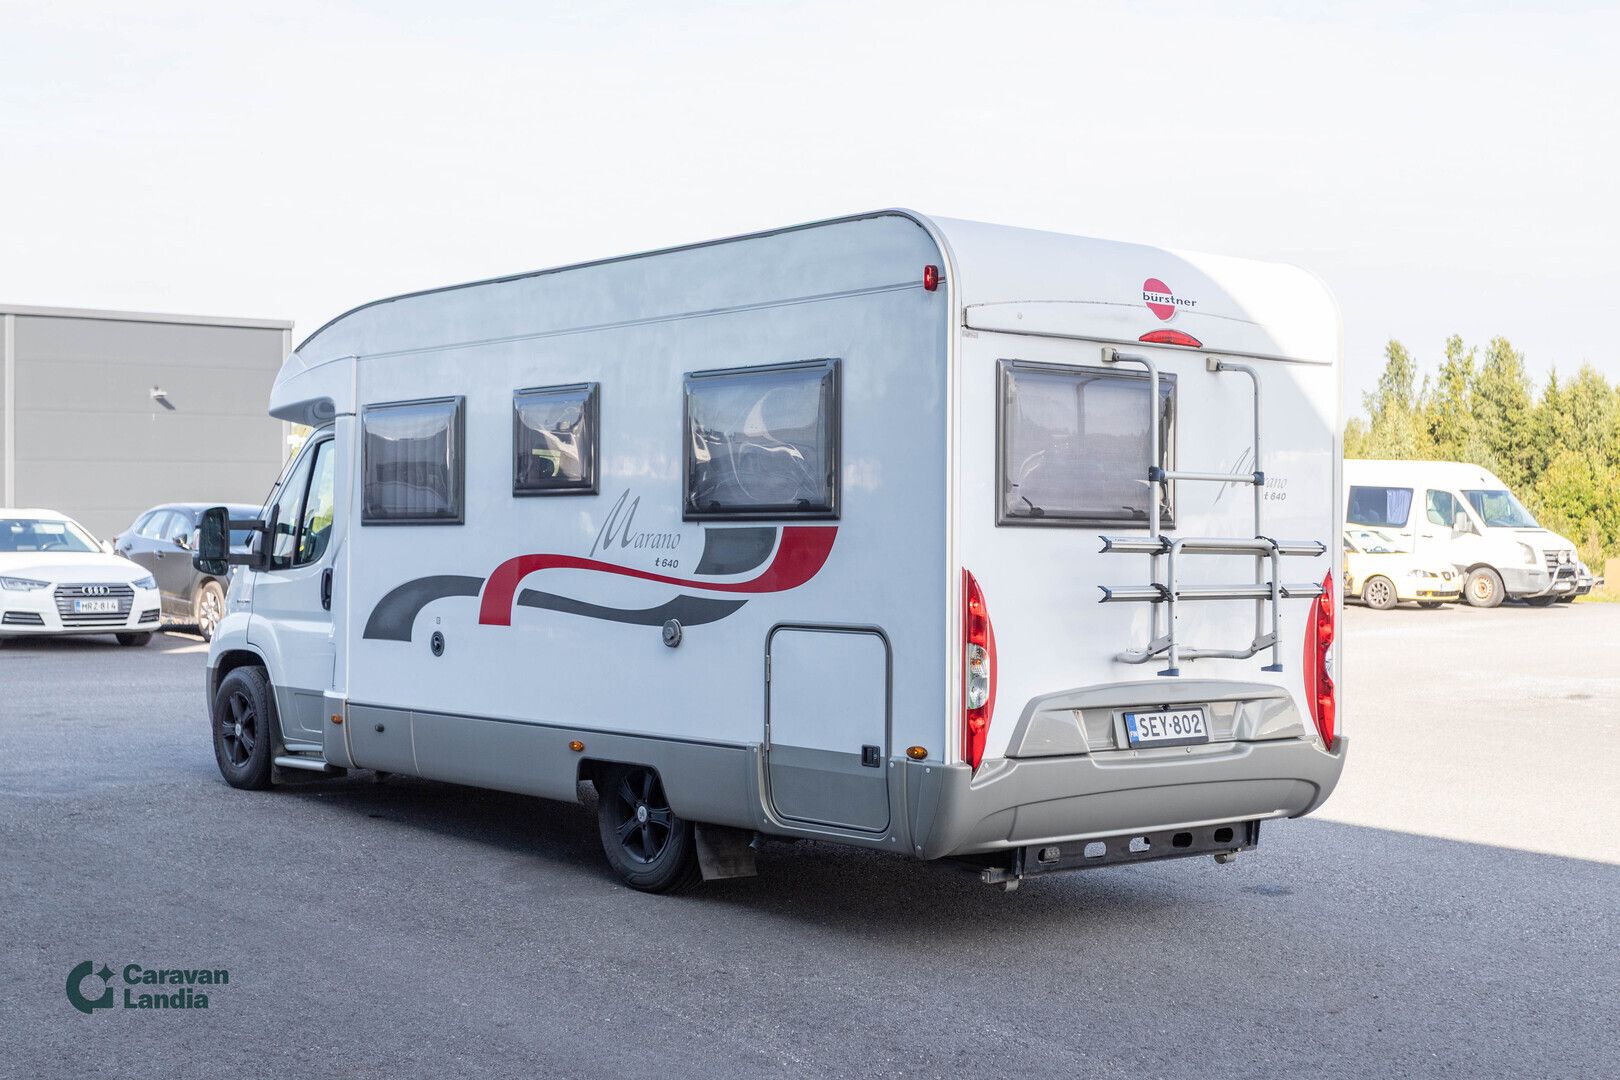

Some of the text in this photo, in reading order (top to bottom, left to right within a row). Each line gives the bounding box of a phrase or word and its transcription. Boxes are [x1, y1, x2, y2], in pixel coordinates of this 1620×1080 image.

[1142, 291, 1197, 306] bürstner
[589, 488, 681, 557] Marano
[661, 558, 679, 568] 640
[1139, 713, 1202, 738] SEY-802
